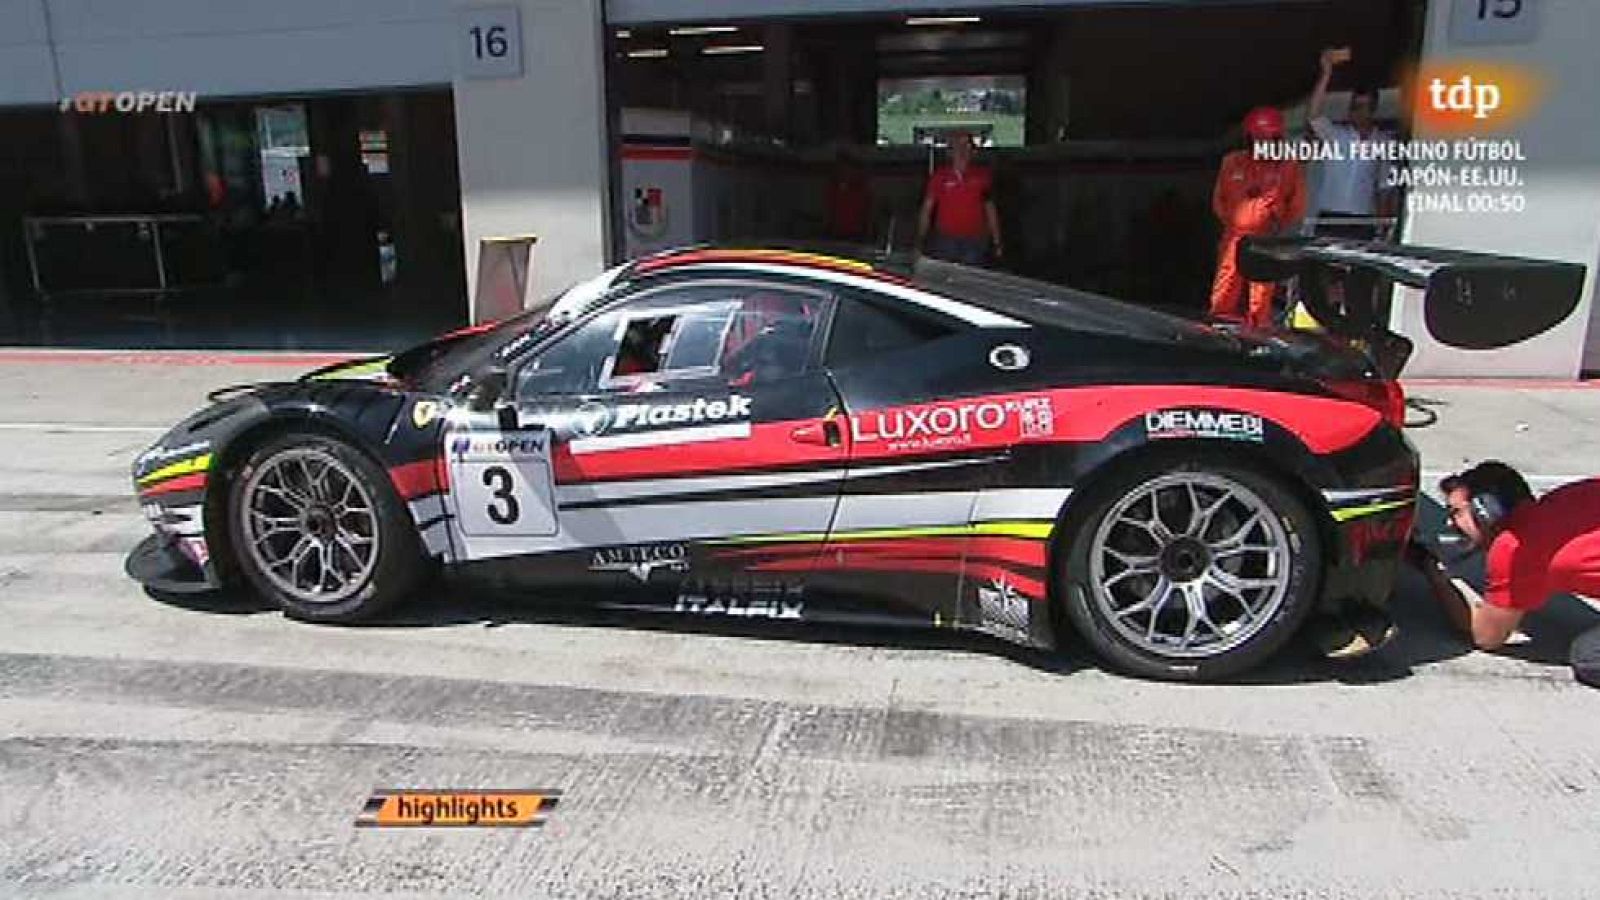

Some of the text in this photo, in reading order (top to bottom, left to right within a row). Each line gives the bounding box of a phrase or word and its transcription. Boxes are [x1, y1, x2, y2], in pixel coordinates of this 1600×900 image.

[469, 27, 508, 59] 16
[612, 394, 752, 429] Plastek
[482, 466, 520, 525] 3
